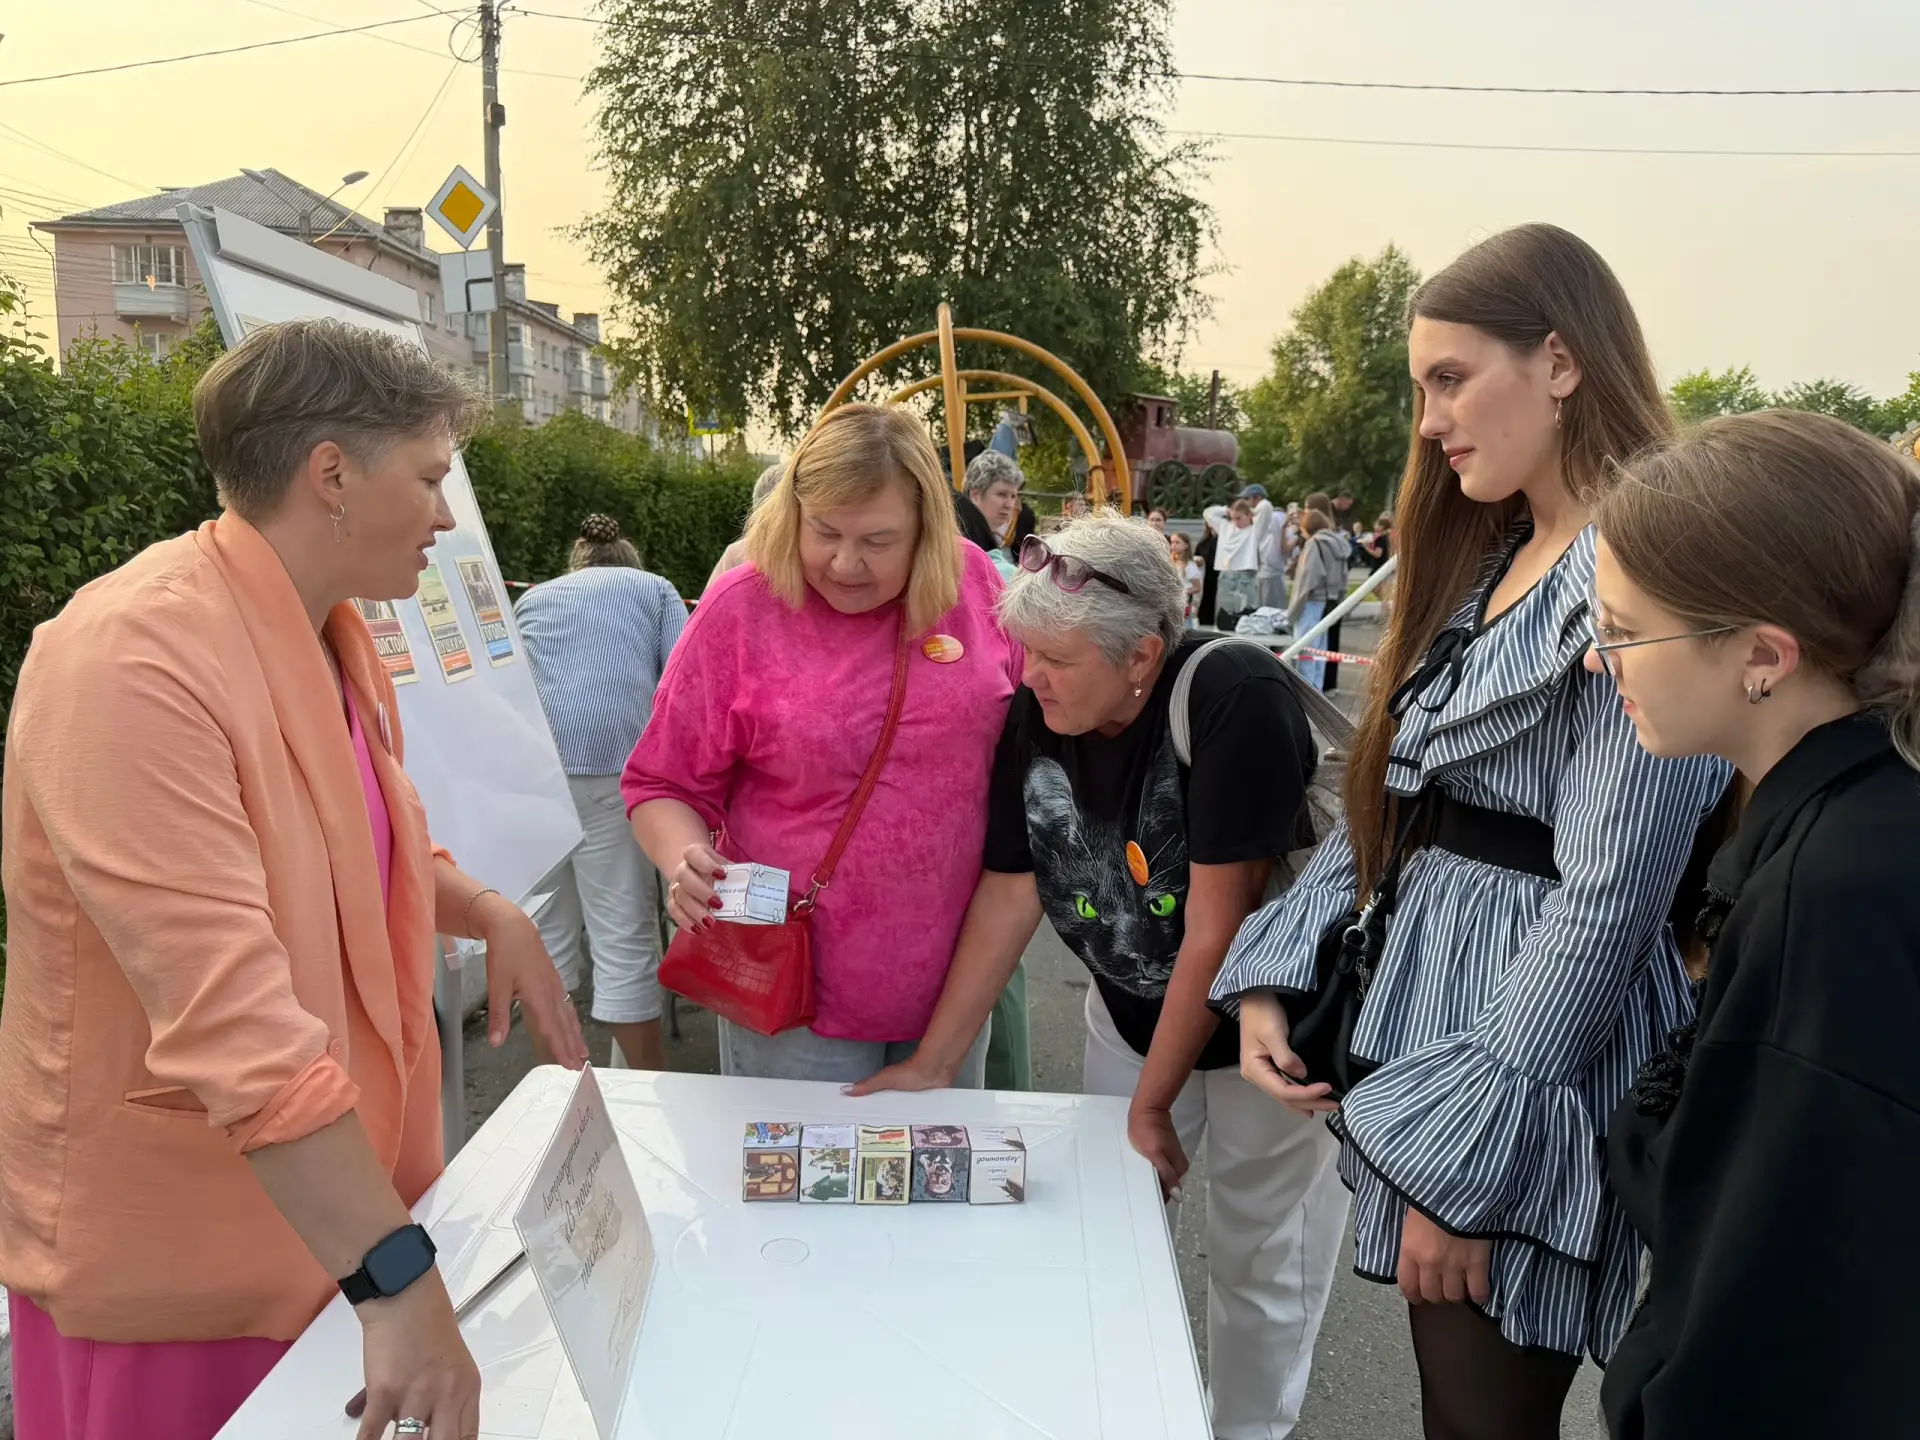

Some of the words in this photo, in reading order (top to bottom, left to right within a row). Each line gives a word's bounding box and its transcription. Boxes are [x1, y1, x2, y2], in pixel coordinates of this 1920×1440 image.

[480, 623, 507, 642] ГОГОЛЬ
[436, 636, 464, 654] ПУШКИН
[976, 1155, 1021, 1165] Лермонтов
[576, 1151, 601, 1216] поисках
